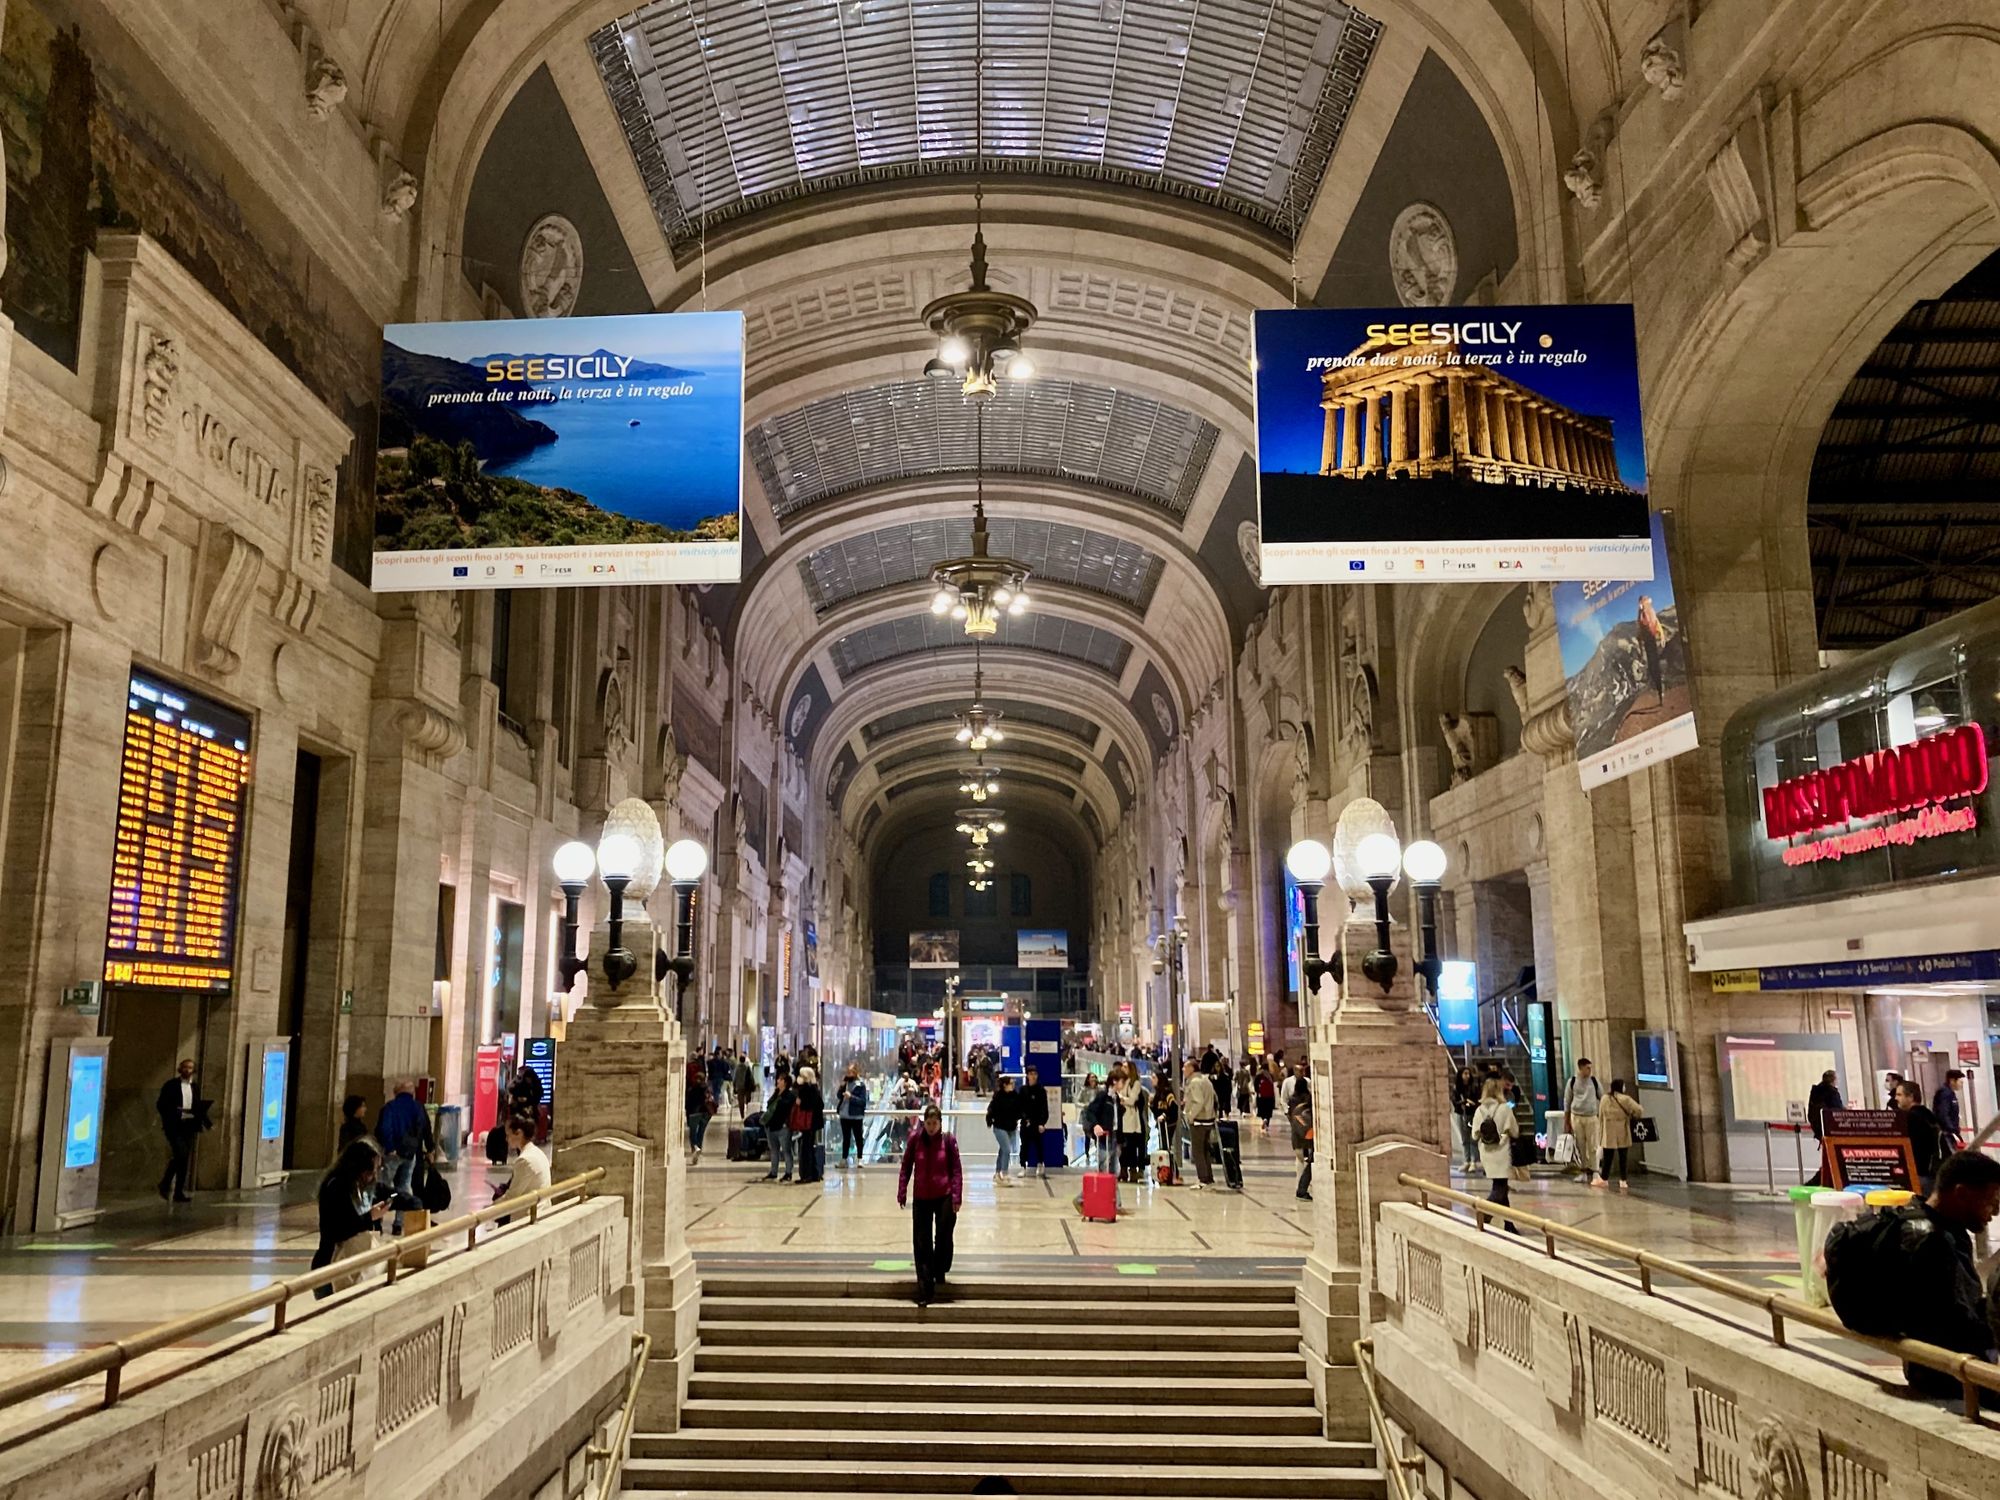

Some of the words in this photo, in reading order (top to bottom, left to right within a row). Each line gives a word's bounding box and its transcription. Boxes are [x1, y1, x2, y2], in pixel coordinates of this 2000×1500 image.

[1366, 322, 1522, 345] SEESICILY
[486, 356, 634, 382] SEESICILY
[1306, 354, 1366, 371] prenota
[1370, 352, 1398, 367] due
[1402, 351, 1442, 369] notti,
[1446, 351, 1461, 365] la
[1465, 351, 1502, 365] terza
[1506, 349, 1515, 364] è
[1519, 349, 1534, 364] in
[1538, 348, 1588, 367] regalo
[428, 390, 483, 407] prenota
[487, 387, 512, 402] due
[518, 387, 556, 403] notti,
[559, 386, 572, 400] la
[577, 386, 611, 399] terza
[616, 384, 624, 397] è
[628, 384, 642, 397] in
[647, 381, 693, 399] regalo
[375, 554, 401, 566] Scopri
[404, 555, 430, 564] anche
[433, 553, 444, 565] gli
[446, 552, 472, 563] sconti
[474, 552, 492, 562] fino
[494, 551, 502, 561] al
[504, 551, 524, 560] 50%
[526, 550, 539, 560] sui
[541, 550, 580, 562] trasporti
[582, 551, 588, 559] e
[594, 549, 624, 559] servizi
[625, 549, 634, 558] in
[635, 548, 666, 560] regalo
[667, 549, 678, 557] su
[1263, 547, 1293, 558] Scopri
[1295, 547, 1322, 557] anche
[1326, 546, 1339, 558] gli
[1341, 547, 1369, 556] sconti
[1371, 546, 1390, 556] fino
[1392, 546, 1401, 555] al
[1403, 546, 1424, 556] 50%
[1426, 546, 1440, 555] sui
[1442, 545, 1483, 556] trasporti
[1485, 546, 1492, 554] e
[1499, 544, 1530, 554] servizi
[1531, 544, 1540, 553] in
[1542, 544, 1573, 556] regalo
[1575, 545, 1586, 553] su
[1588, 543, 1650, 555] visitsicily.info
